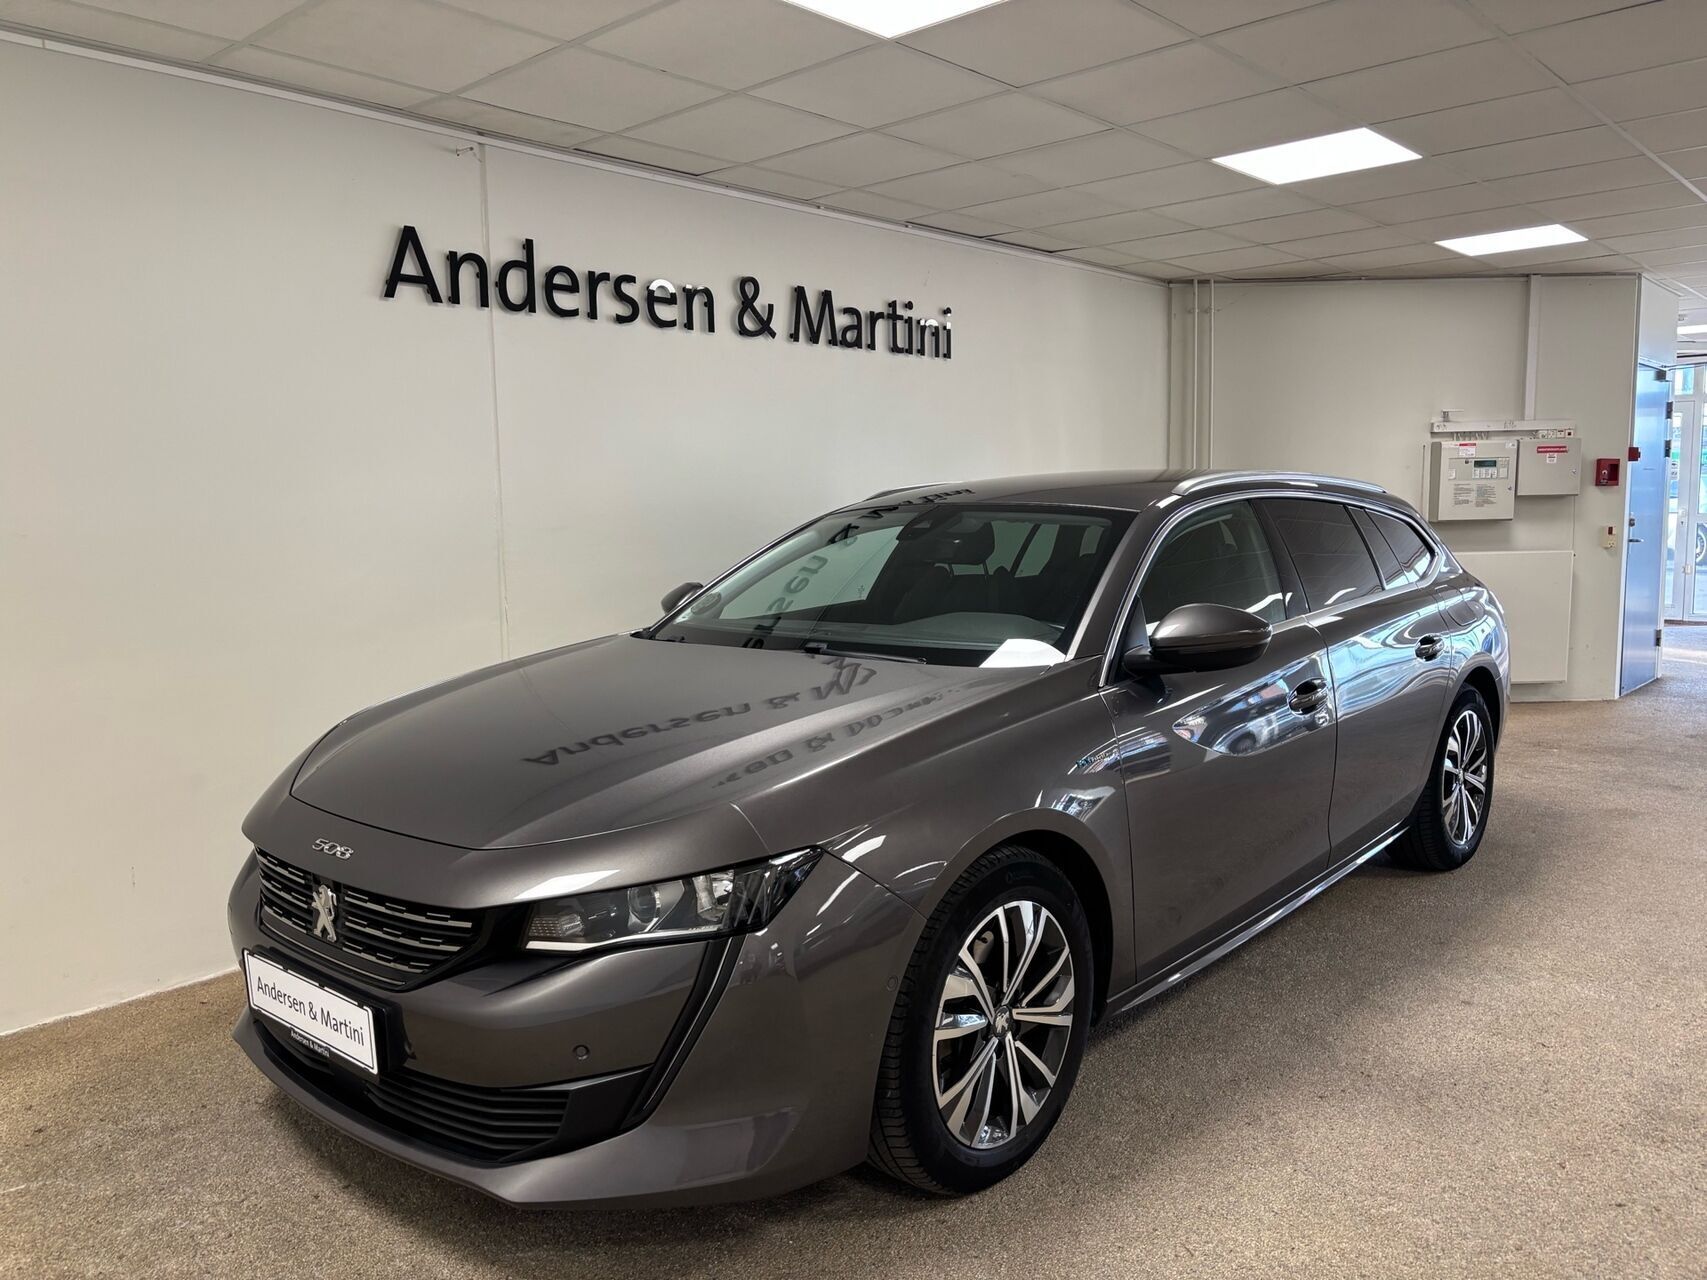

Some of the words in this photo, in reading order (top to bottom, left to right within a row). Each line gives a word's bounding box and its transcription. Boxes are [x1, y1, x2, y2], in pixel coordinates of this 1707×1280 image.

[384, 225, 716, 334] Andersen
[737, 275, 777, 340] &
[789, 284, 952, 359] Martini
[312, 838, 354, 859] 508
[256, 976, 307, 1017] Andersen
[308, 1001, 318, 1022] &
[320, 1007, 365, 1046] Martini
